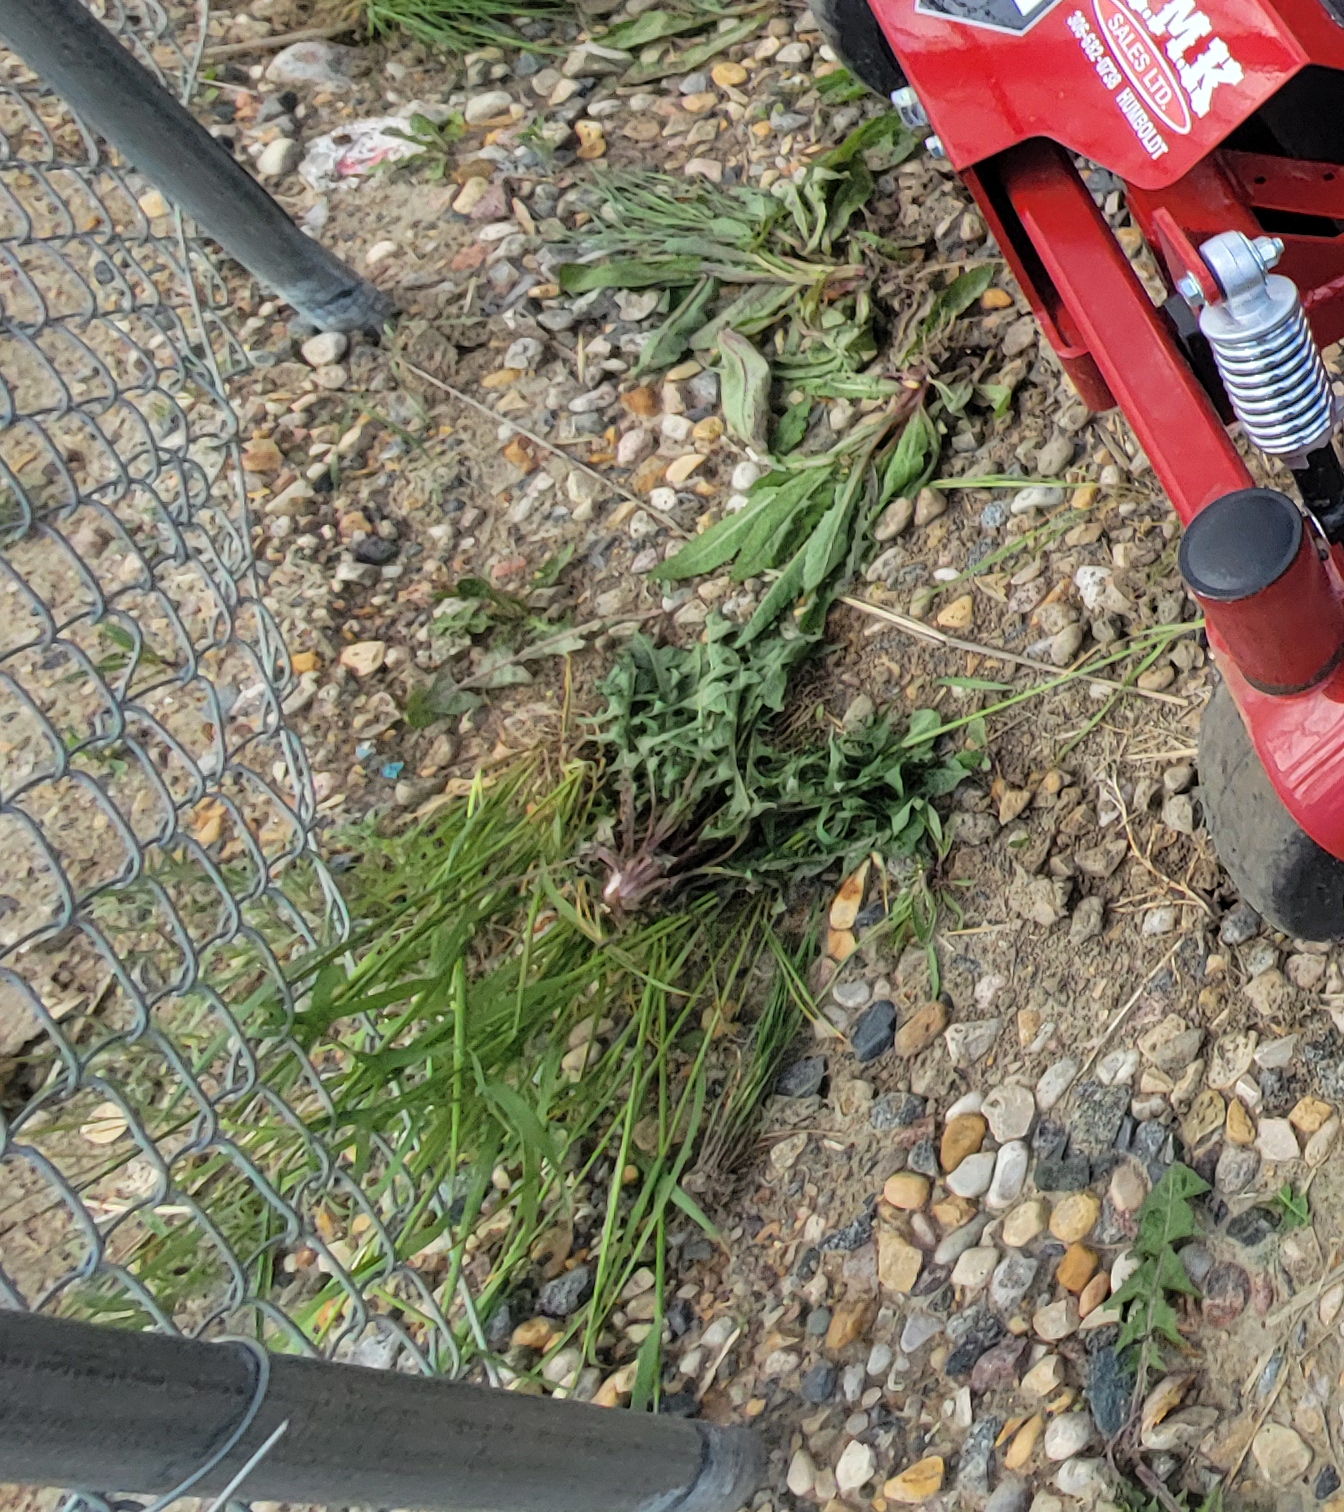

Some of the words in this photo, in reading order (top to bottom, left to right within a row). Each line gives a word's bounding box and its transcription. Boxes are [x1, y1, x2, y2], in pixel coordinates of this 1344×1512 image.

[1108, 13, 1151, 72] SALES
[1142, 67, 1173, 111] LTD.
[1115, 86, 1169, 161] HUMBOLDT
